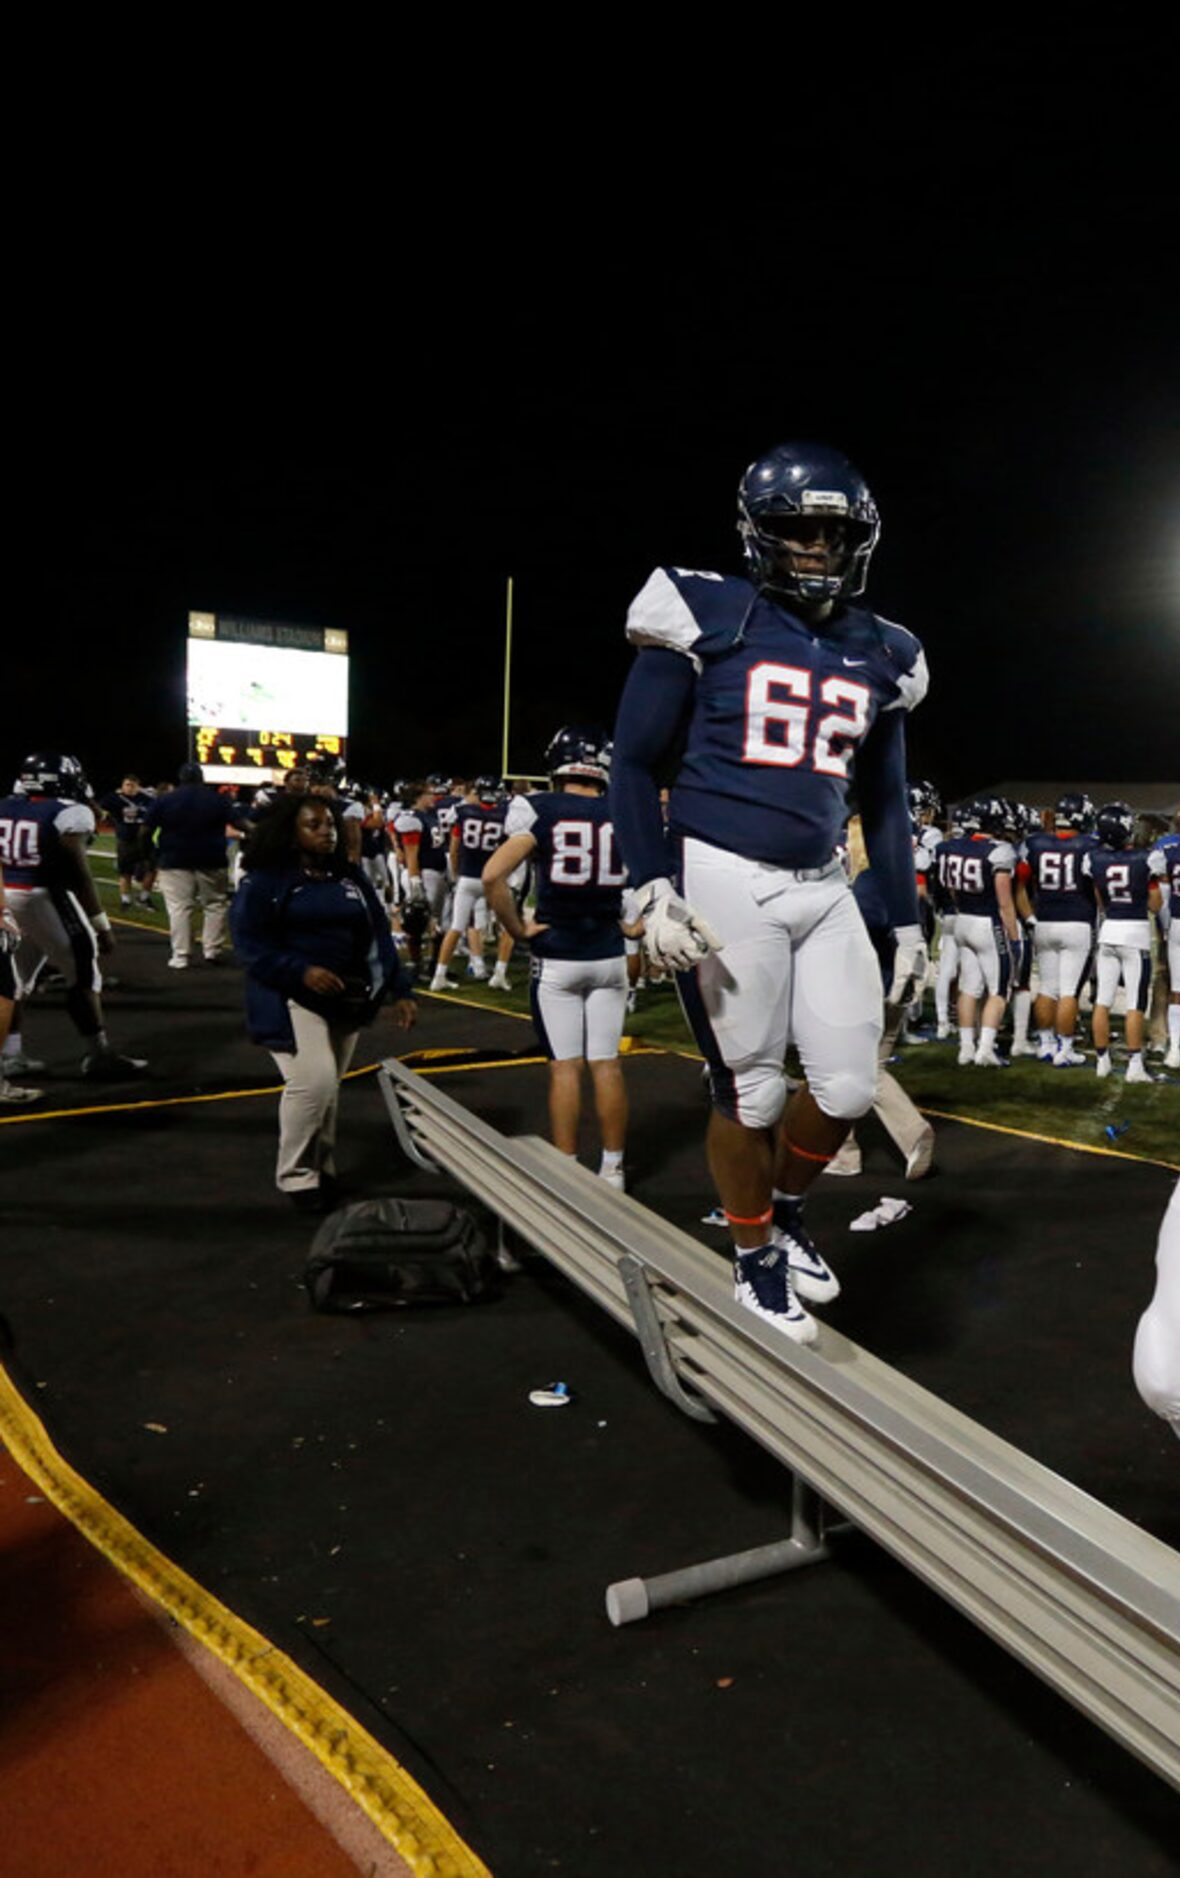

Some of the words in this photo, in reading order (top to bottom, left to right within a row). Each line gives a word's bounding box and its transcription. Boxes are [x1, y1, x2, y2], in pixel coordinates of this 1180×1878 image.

[744, 661, 872, 777] 62
[463, 818, 503, 850] 82
[1039, 851, 1078, 892] 61
[1105, 864, 1133, 903] 2
